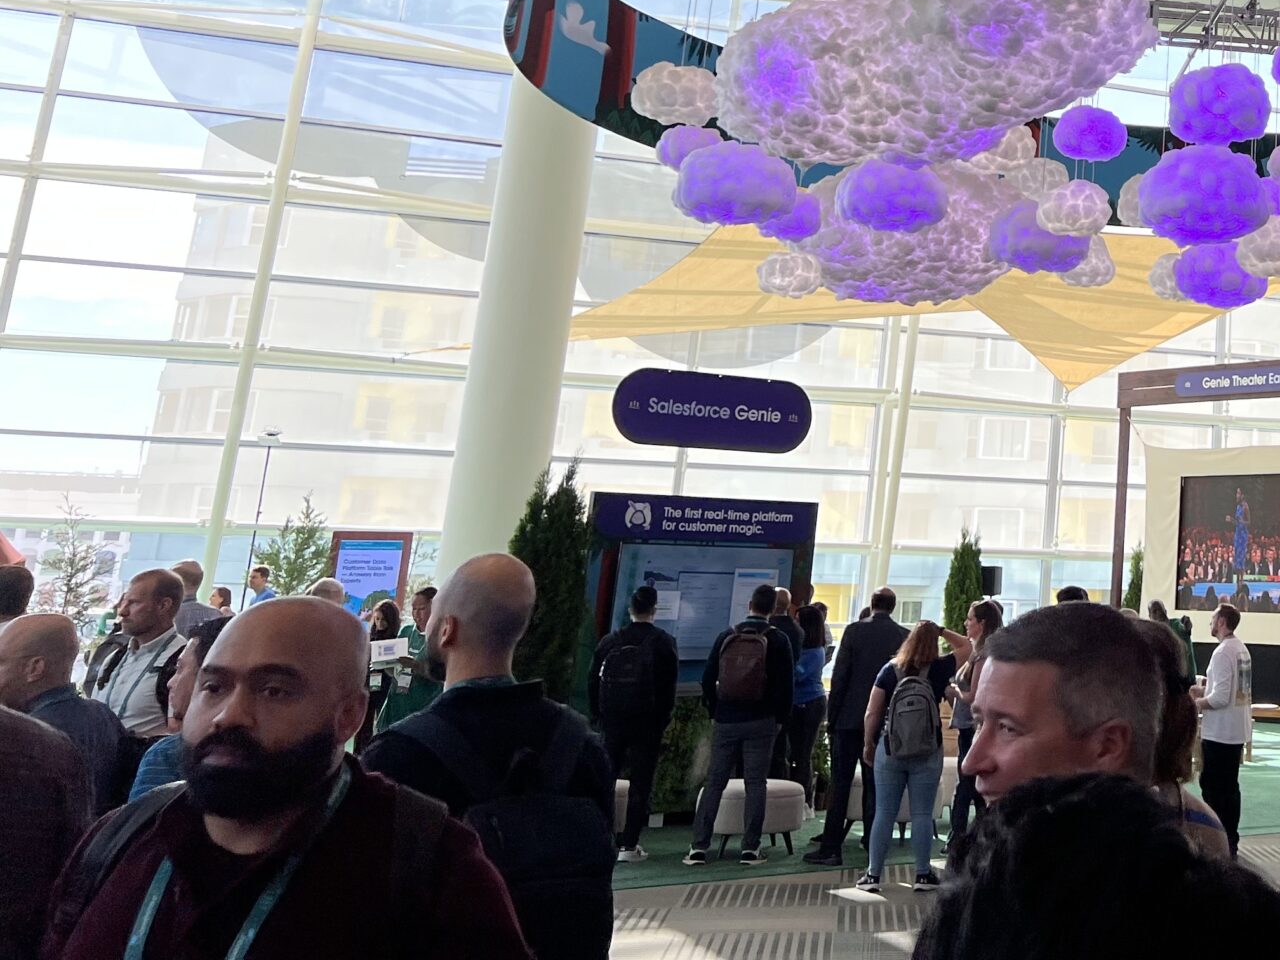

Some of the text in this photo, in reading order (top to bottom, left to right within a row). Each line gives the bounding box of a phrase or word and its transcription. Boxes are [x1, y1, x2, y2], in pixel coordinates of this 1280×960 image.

[1202, 376, 1230, 389] Genie
[1232, 374, 1267, 387] Theater
[648, 397, 782, 424] Salesforce Genie
[663, 507, 794, 523] The first real-time platform
[662, 520, 765, 536] for customer magic.
